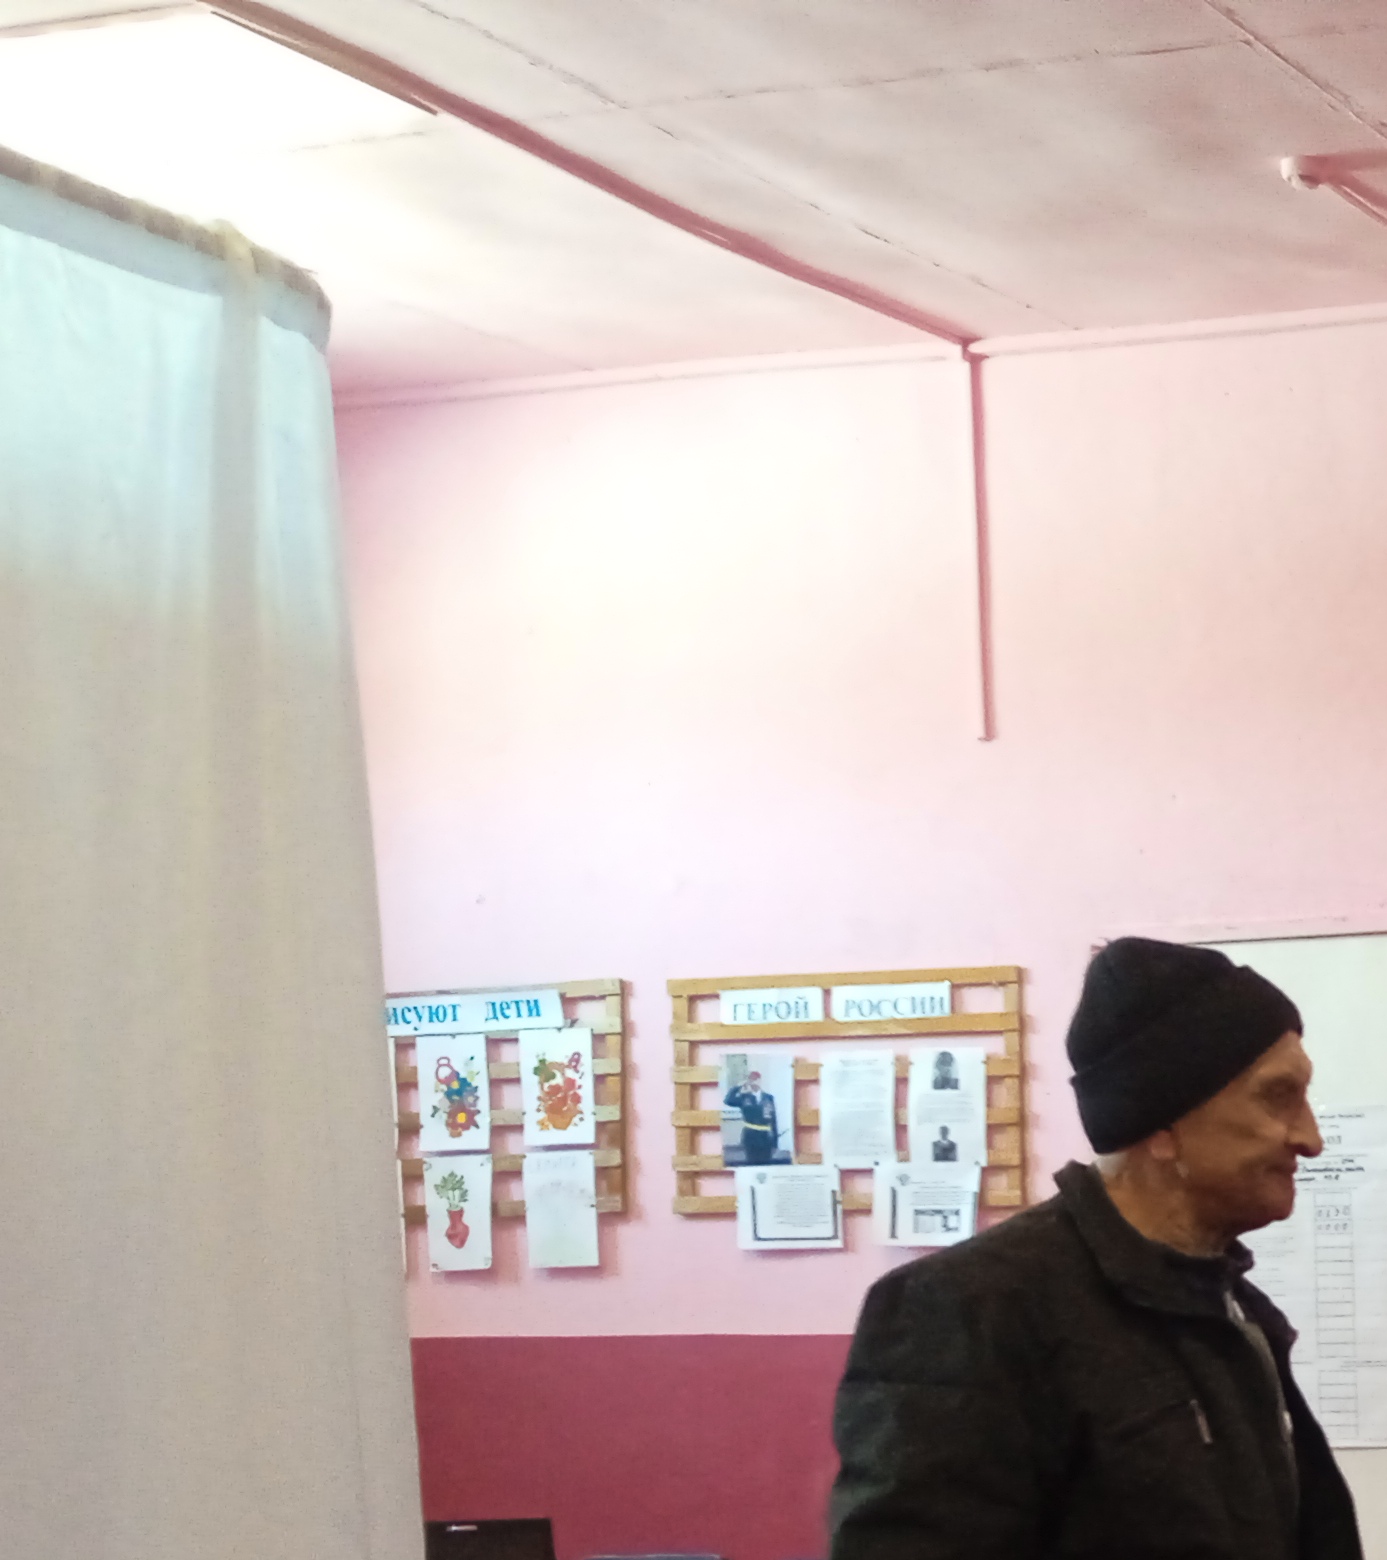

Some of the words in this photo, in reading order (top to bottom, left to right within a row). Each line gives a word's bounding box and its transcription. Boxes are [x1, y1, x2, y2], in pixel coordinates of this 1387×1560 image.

[386, 1003, 461, 1031] исуют
[484, 998, 542, 1022] дети
[733, 996, 811, 1021] ГЕРОЙ
[843, 995, 950, 1018] РОССИИ
